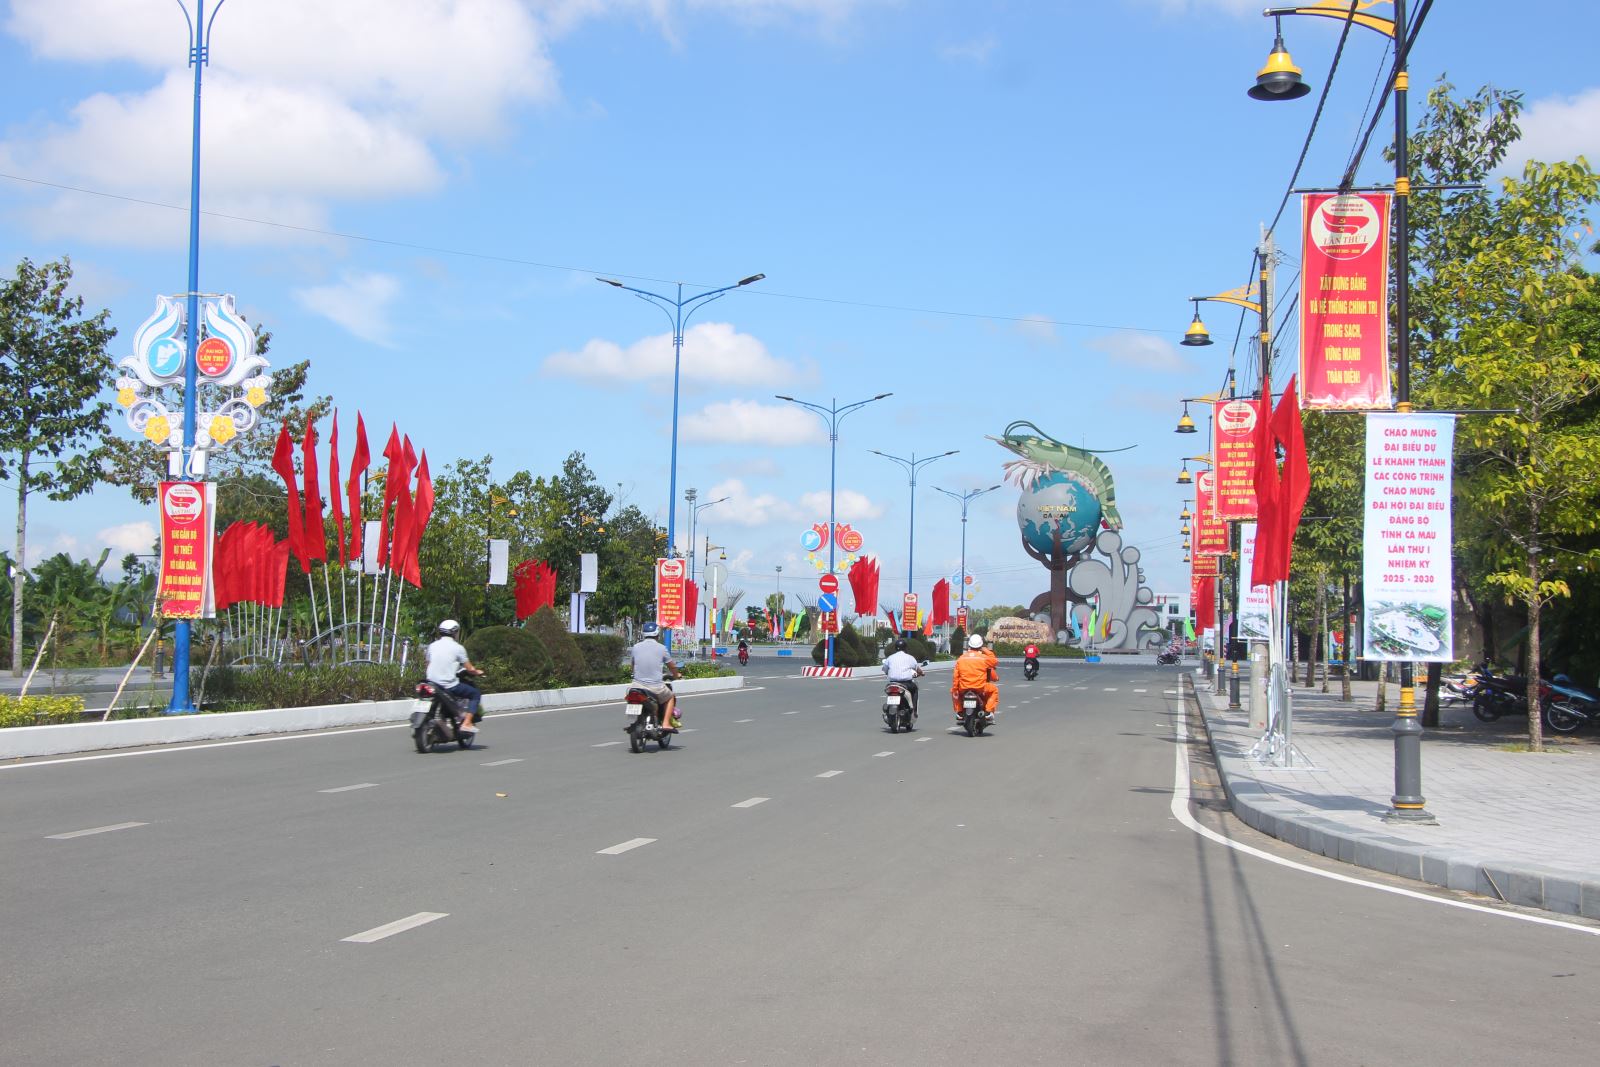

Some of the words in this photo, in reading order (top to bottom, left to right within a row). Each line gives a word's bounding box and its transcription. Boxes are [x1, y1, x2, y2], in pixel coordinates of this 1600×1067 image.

[1350, 272, 1367, 291] ĐẢNG
[1323, 323, 1343, 338] TRONG
[1389, 513, 1414, 524] ĐẢNG
[1418, 531, 1436, 539] MAU
[1383, 574, 1405, 583] 2025
[1413, 575, 1434, 583] 2030
